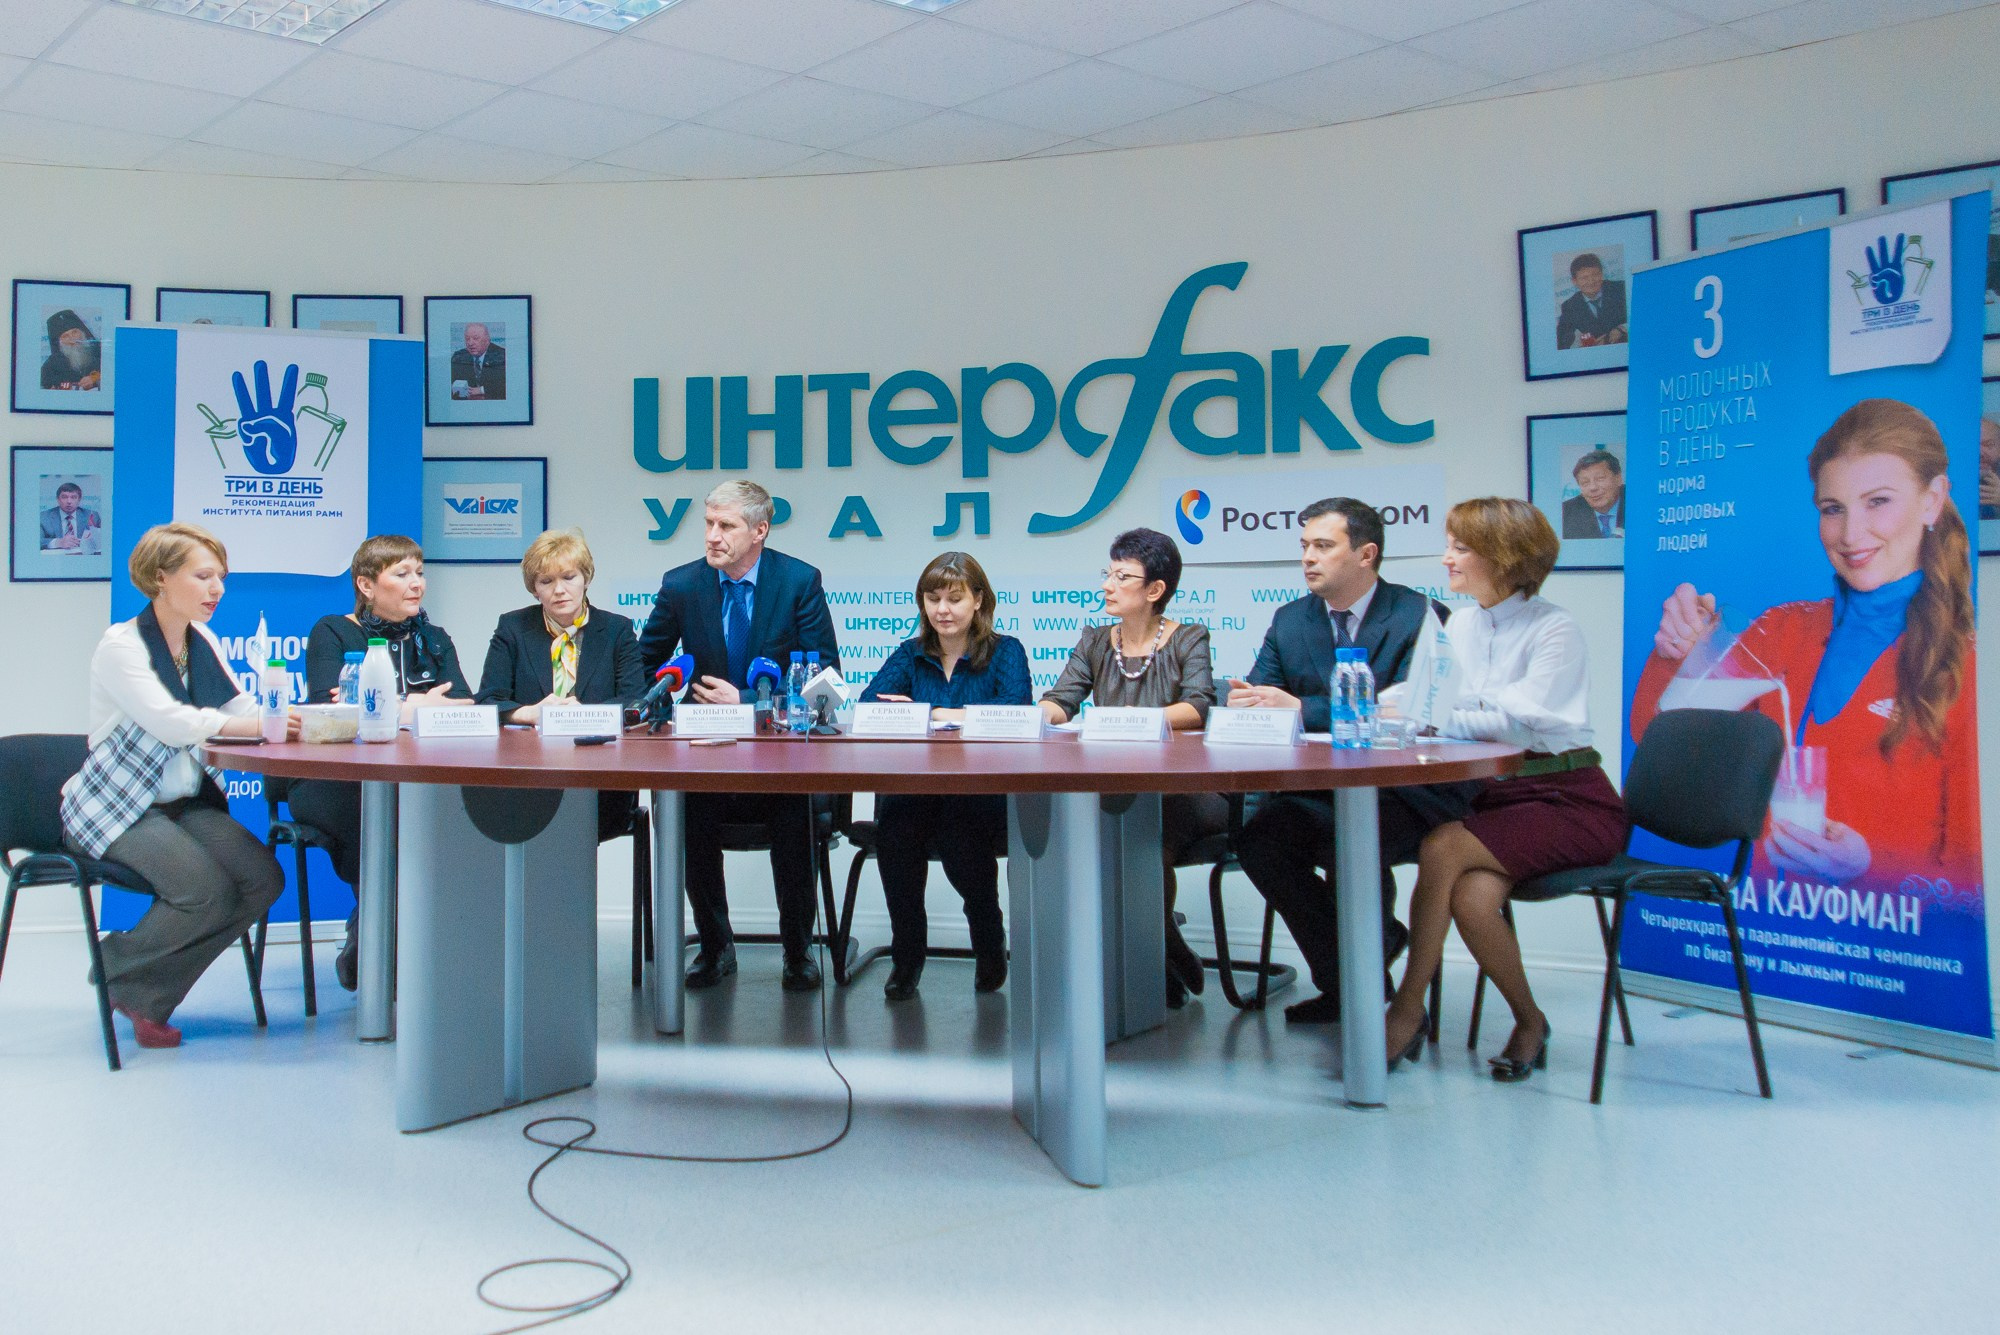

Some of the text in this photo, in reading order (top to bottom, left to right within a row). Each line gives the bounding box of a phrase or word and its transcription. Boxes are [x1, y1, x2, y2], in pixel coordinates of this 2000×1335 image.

[1693, 275, 1724, 359] 3
[1659, 360, 1773, 404] МОЛОЧНЫХ
[632, 261, 1435, 536] интерфакс
[1659, 396, 1758, 435] ПРОДУКТА
[1659, 440, 1670, 467] В
[1676, 433, 1726, 468] ДЕНЬ
[224, 480, 324, 495] ТРИ В ДЕНЬ
[1658, 474, 1706, 496] норма
[202, 508, 343, 518] ИНСТИТУТА ПИТАНИЯ РАМН
[231, 499, 316, 508] РЕКОМЕНДАЦИЯ
[1656, 501, 1737, 526] здоровых
[1655, 528, 1708, 554] людей
[1175, 589, 1216, 604] РАЛ
[432, 711, 482, 719] СТАФЕЕВА
[871, 707, 911, 715] СЕРКОВА
[1767, 878, 1921, 936] КАУФМАН
[1748, 927, 1870, 960] паралимпийская
[1873, 946, 1964, 975] чемпионка
[1684, 943, 1700, 959] по
[1767, 955, 1776, 972] и
[1779, 959, 1847, 984] лыжным
[1849, 971, 1906, 994] гонкам
